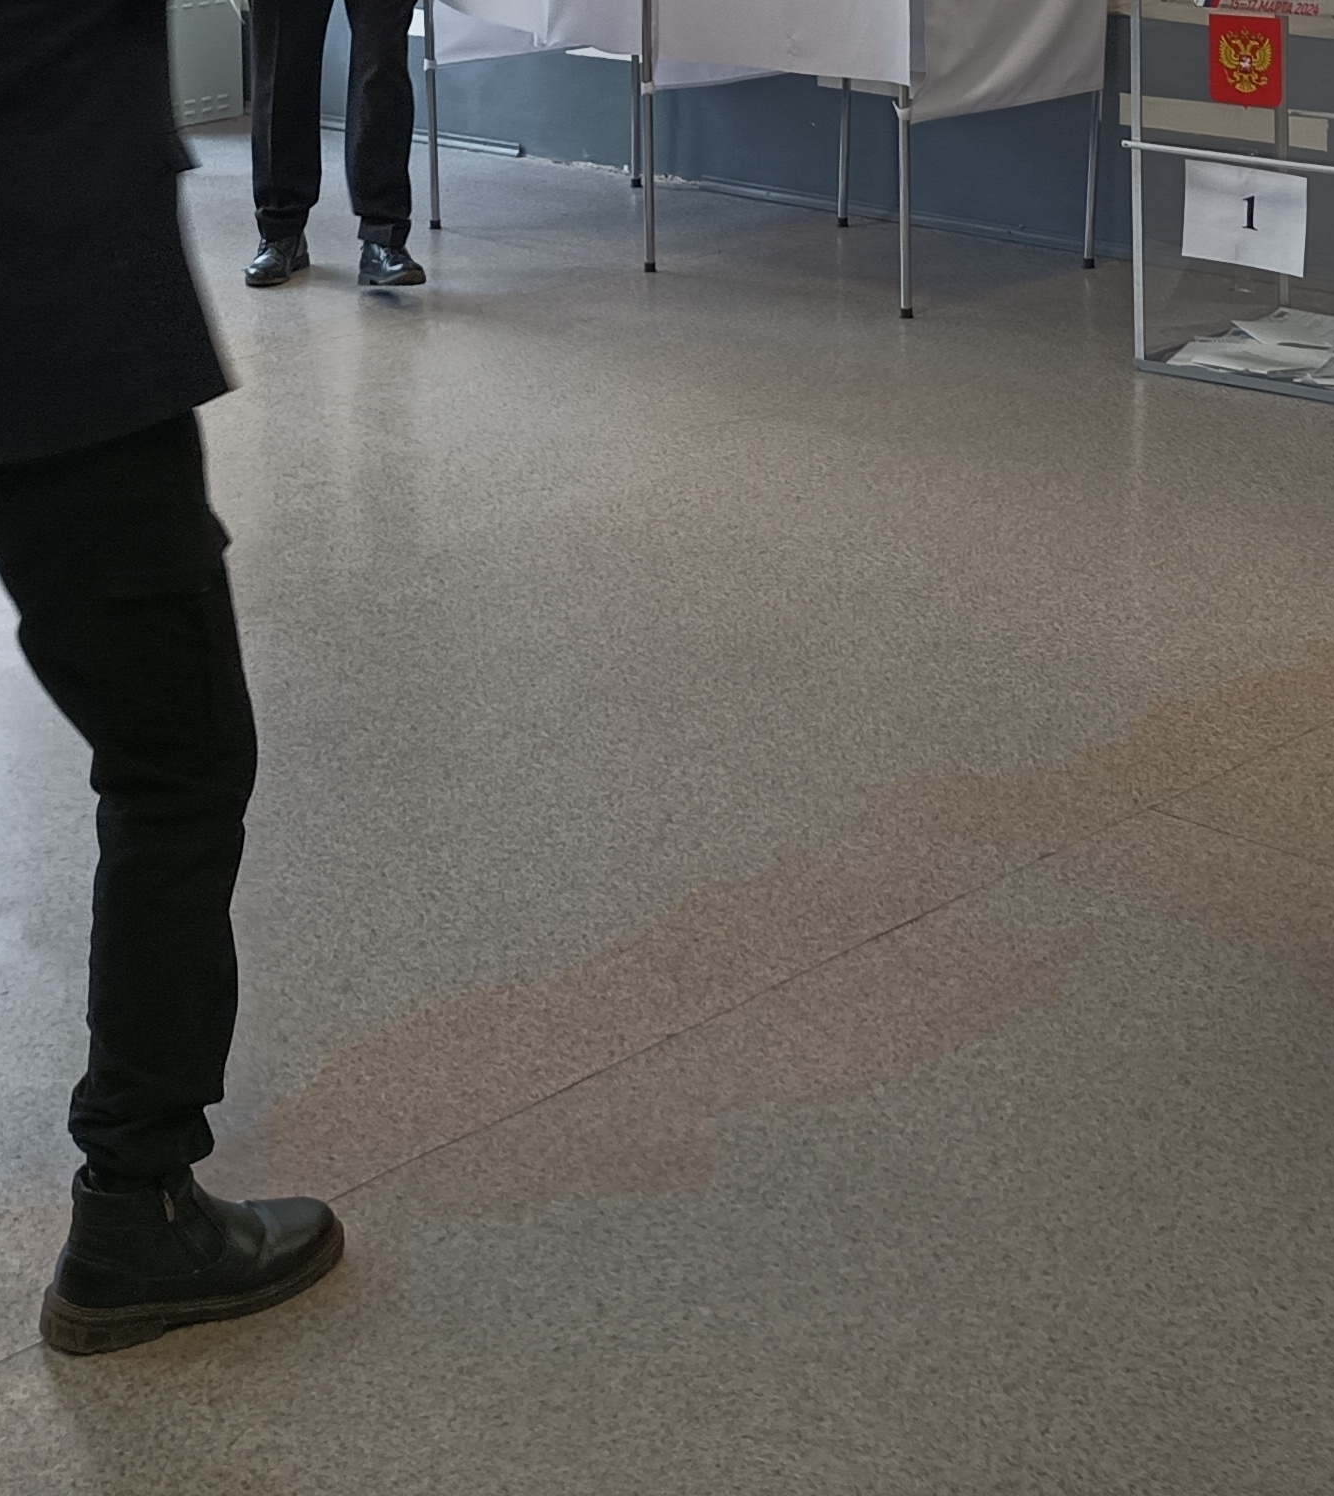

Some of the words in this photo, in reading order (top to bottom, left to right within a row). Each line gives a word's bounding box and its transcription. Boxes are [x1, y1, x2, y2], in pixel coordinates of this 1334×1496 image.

[1259, 0, 1293, 15] МАРТА
[1293, 3, 1320, 16] 2024
[1241, 195, 1258, 232] 1
